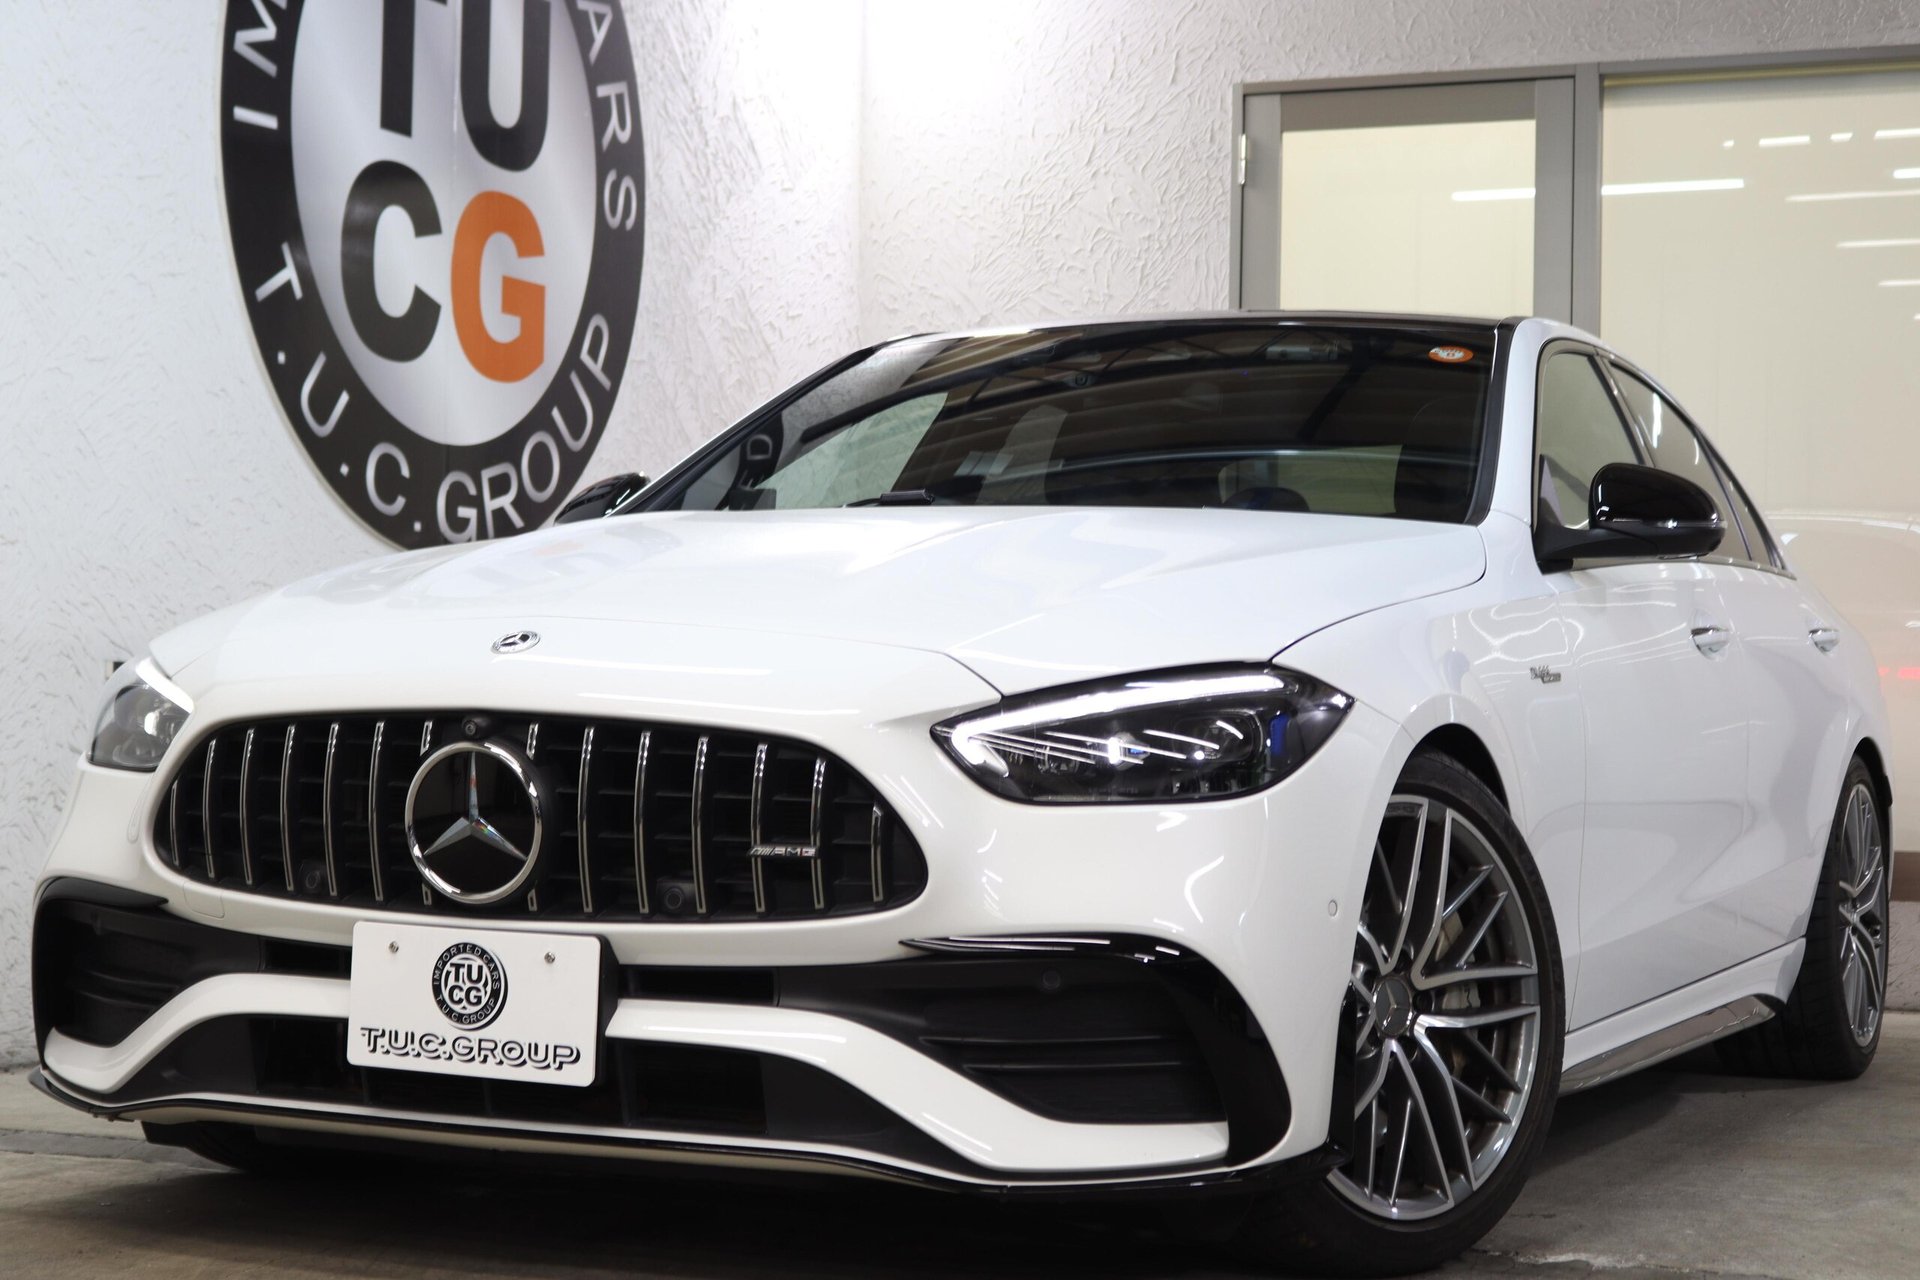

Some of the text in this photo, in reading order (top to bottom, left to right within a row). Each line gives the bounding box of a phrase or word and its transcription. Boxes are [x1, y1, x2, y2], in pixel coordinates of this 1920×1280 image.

[340, 159, 546, 384] CG
[433, 943, 500, 990] IMPORTED CARS
